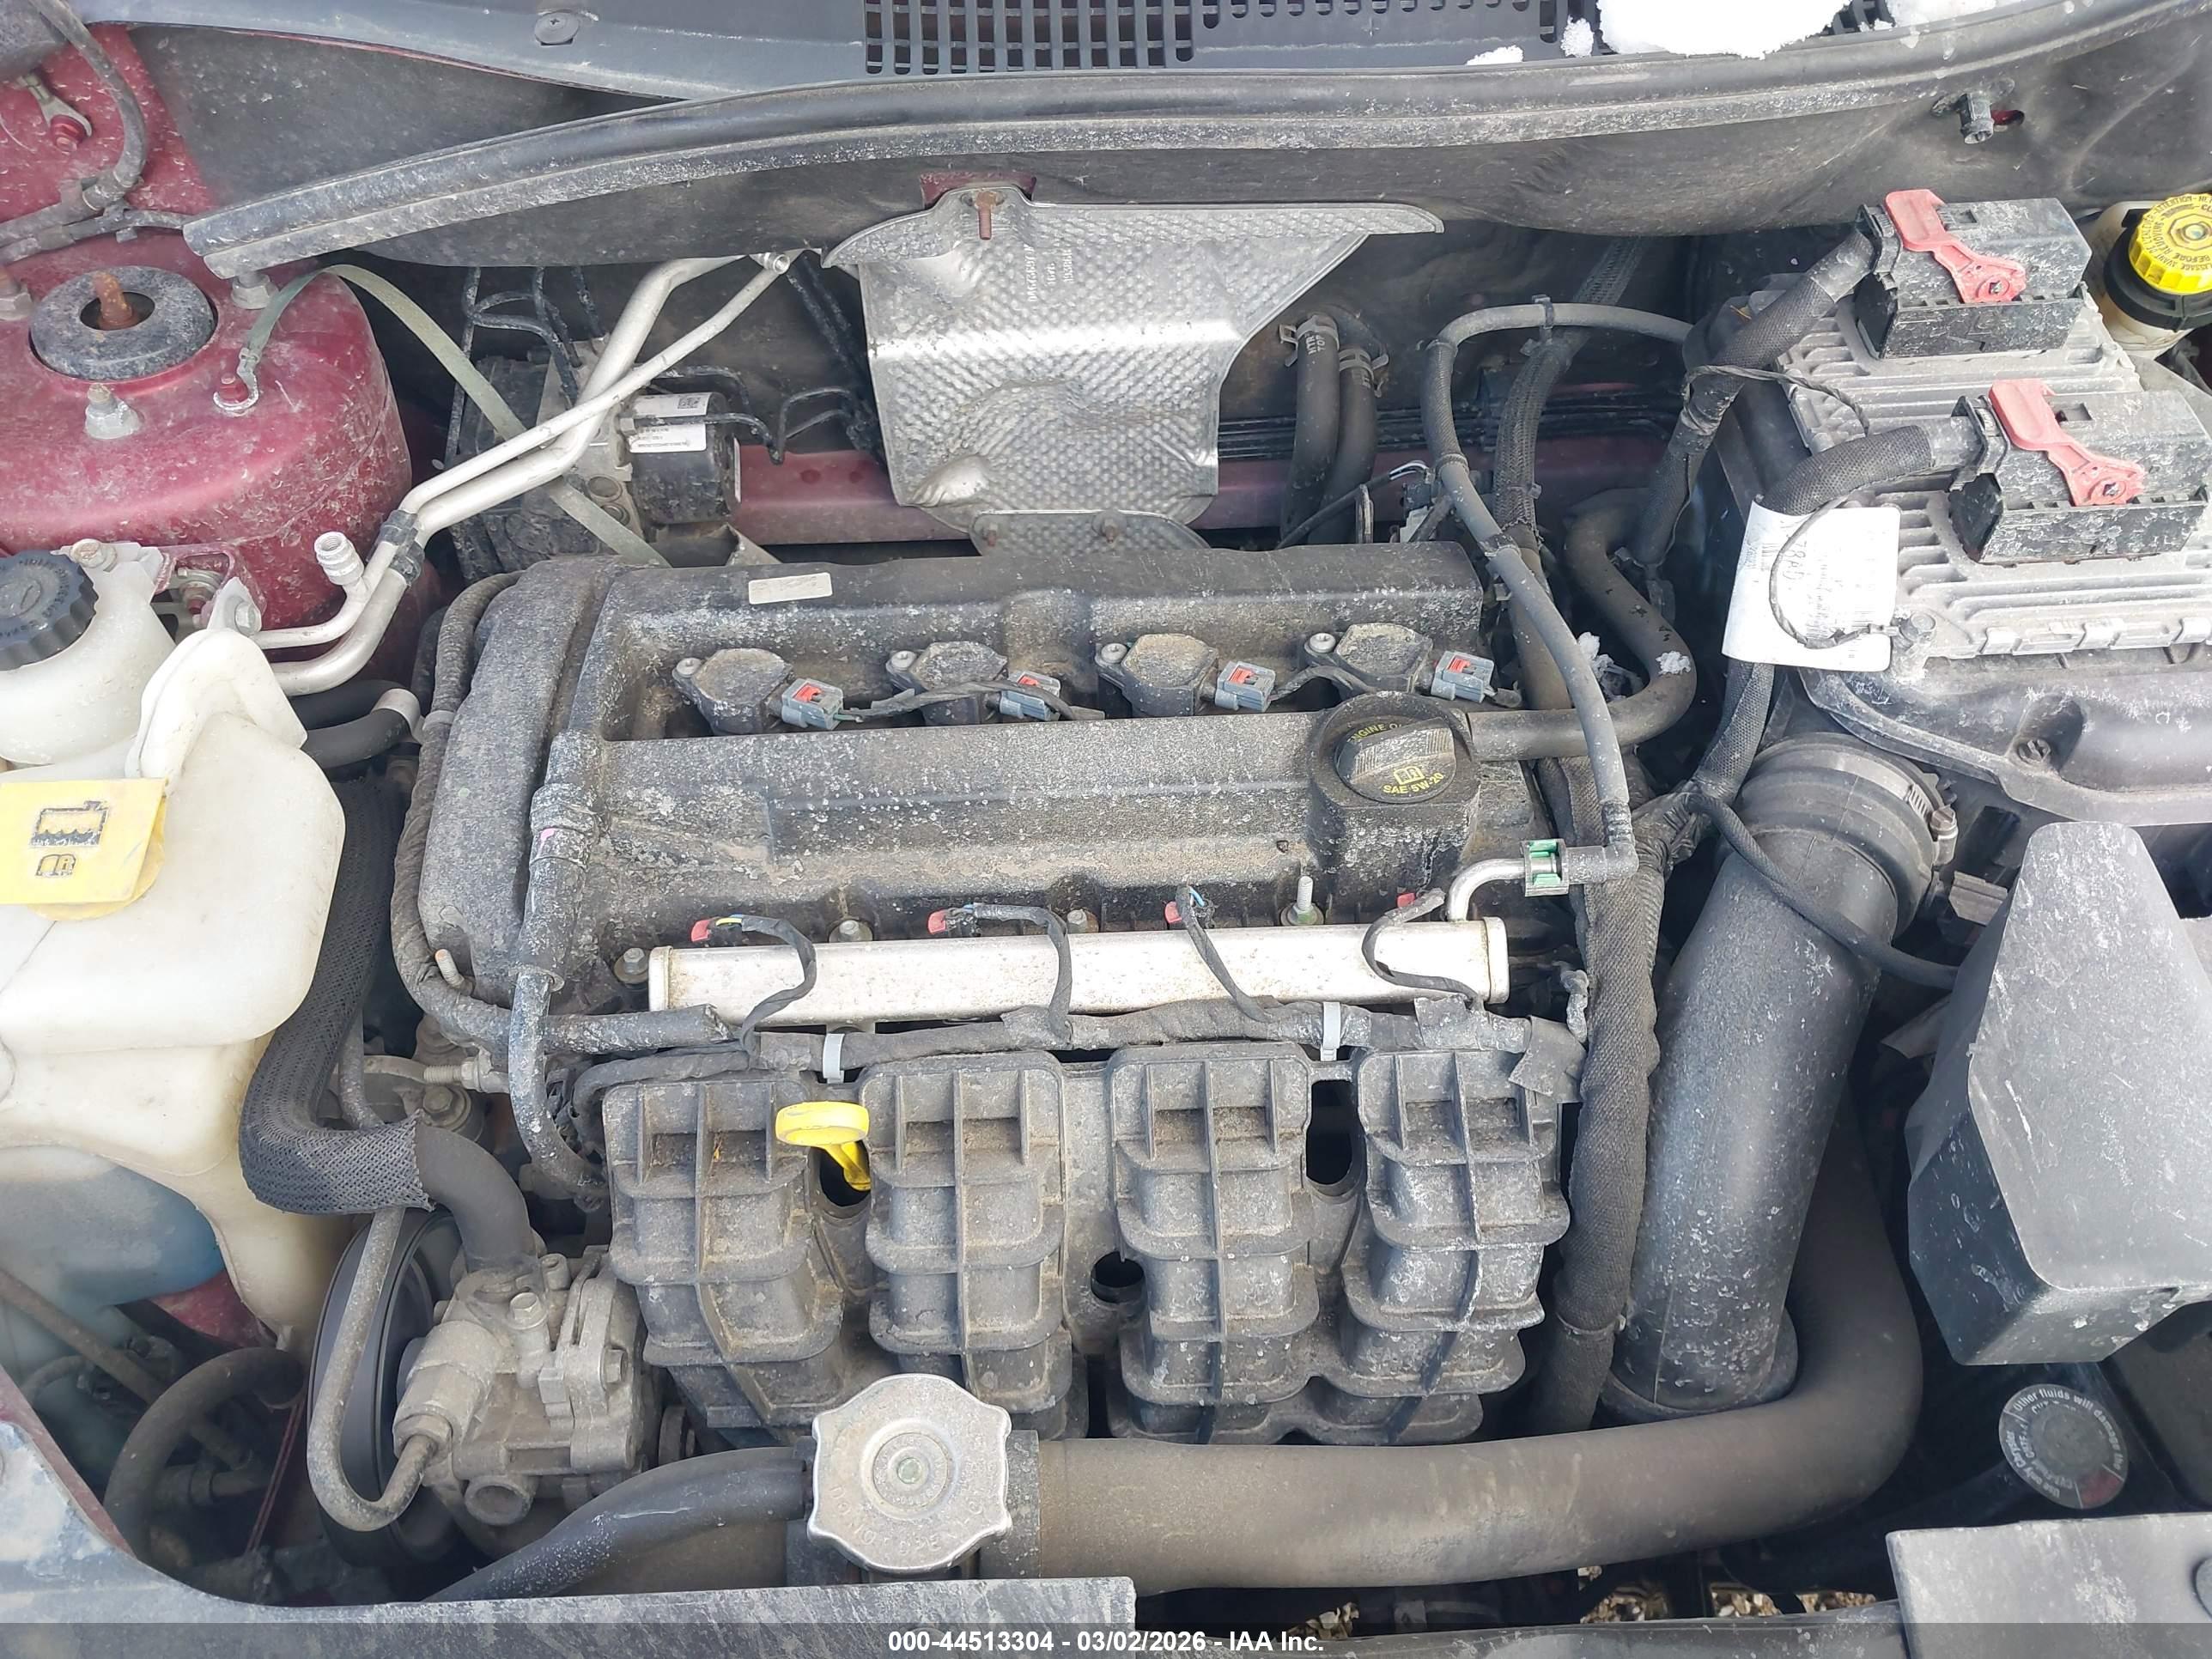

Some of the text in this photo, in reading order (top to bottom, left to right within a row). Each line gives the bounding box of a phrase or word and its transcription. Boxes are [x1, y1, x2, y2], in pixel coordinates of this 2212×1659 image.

[1383, 773, 1444, 794] SAE 5W-20
[2014, 1392, 2038, 1412] Other
[2039, 1389, 2070, 1400] fluids
[2074, 1395, 2094, 1410] will
[2094, 1409, 2121, 1451] damage
[2113, 1452, 2124, 1470] the
[2006, 1431, 2060, 1498] Use only Chrysler
